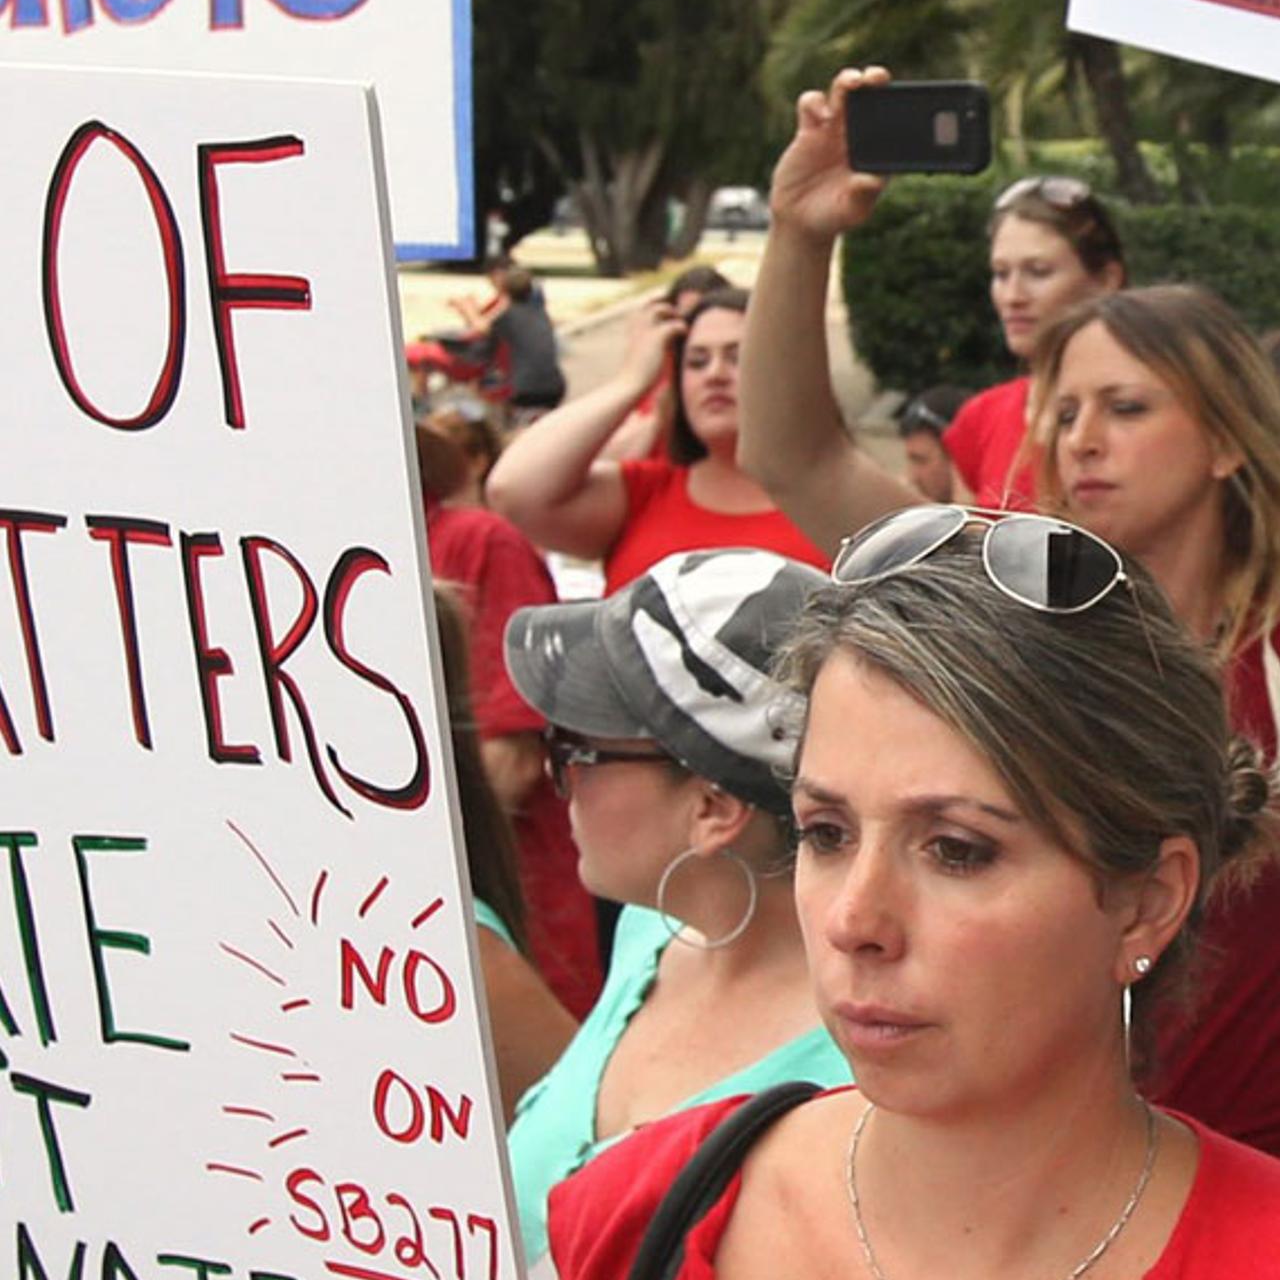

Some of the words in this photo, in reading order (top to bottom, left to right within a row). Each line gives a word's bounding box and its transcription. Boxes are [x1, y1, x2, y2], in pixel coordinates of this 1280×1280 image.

[41, 119, 312, 432] OF
[0, 509, 431, 820] TTERS
[0, 832, 190, 1052] TE
[339, 938, 456, 1024] NO
[372, 1069, 473, 1144] ON
